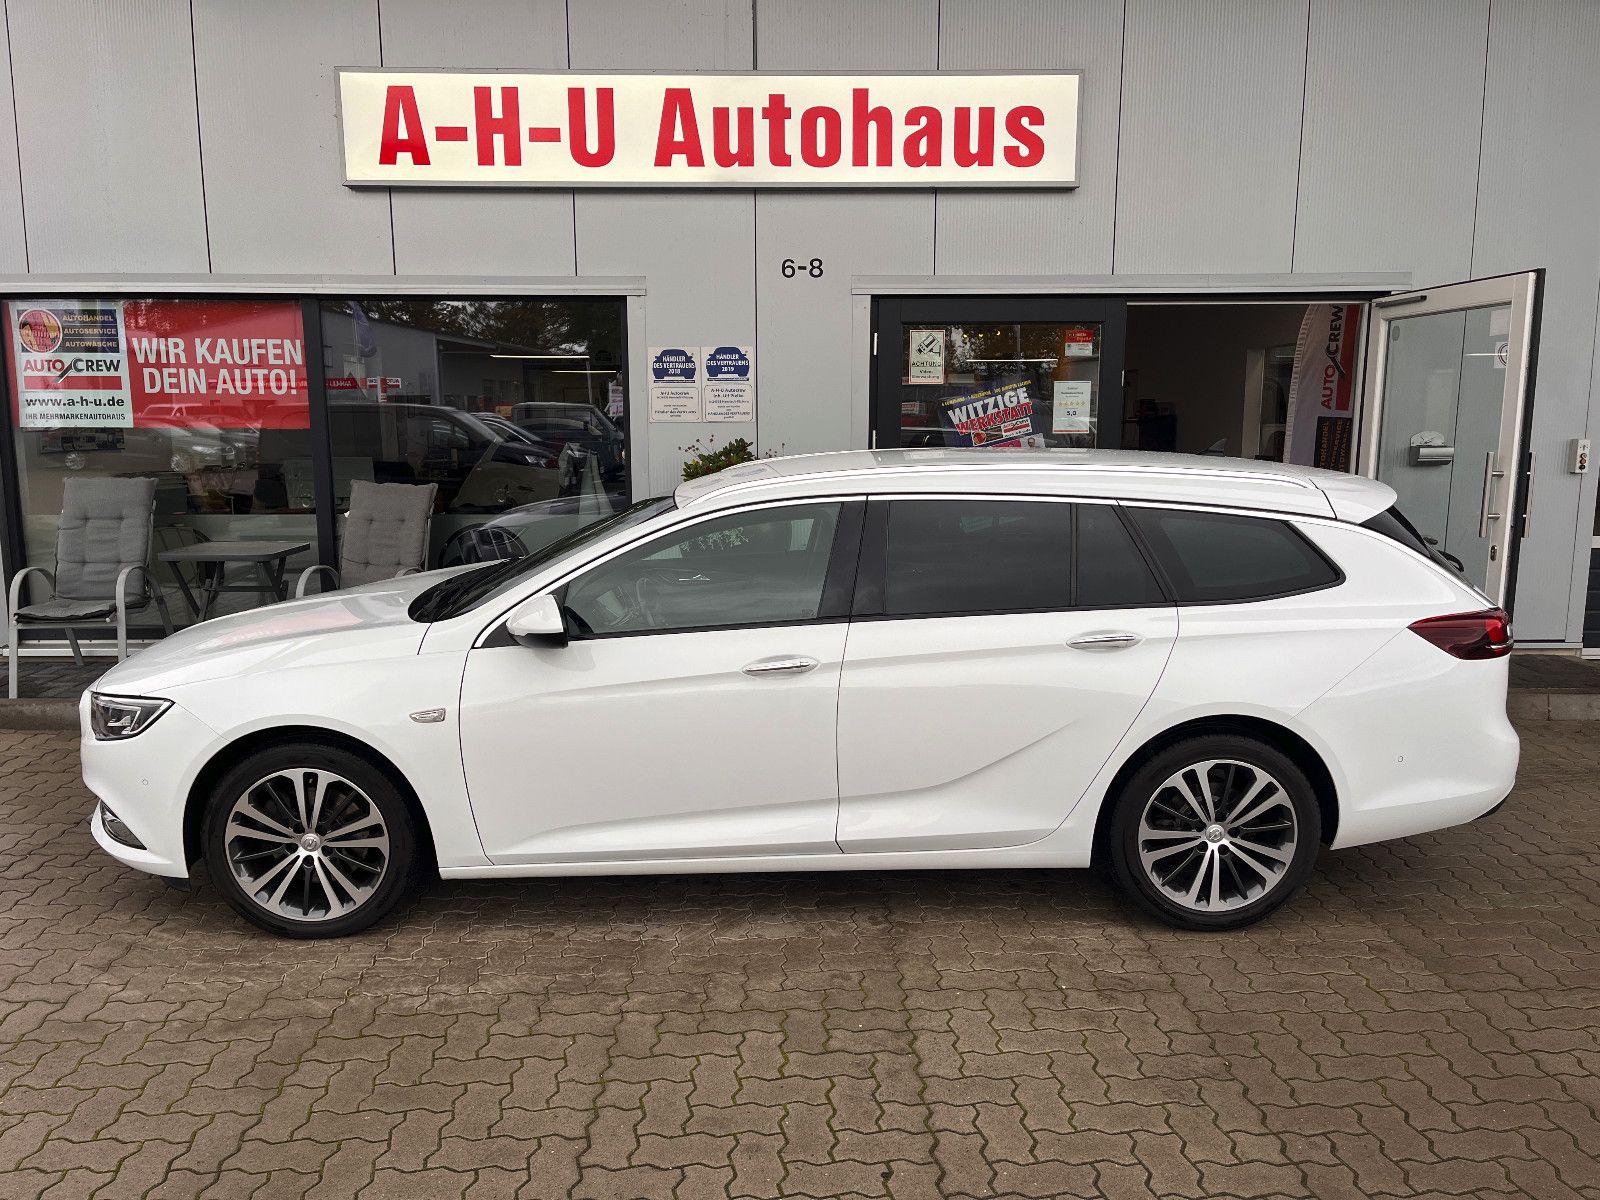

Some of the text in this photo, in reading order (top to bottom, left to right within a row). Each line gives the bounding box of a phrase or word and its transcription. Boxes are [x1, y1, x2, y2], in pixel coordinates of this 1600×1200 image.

[378, 85, 1046, 168] A-H-U Autohaus
[781, 258, 824, 279] 6-8
[62, 314, 114, 322] AUTOHANDEL
[23, 358, 121, 372] AUTO CREW
[132, 337, 303, 366] WIR KAUFEN
[1320, 303, 1344, 410] AUTO CREW
[142, 367, 297, 395] DEIN AUTO!
[25, 396, 125, 407] www.a-h-u.de
[947, 387, 1031, 423] WITZIGE
[955, 401, 1034, 436] WERKSTATT
[1319, 421, 1330, 467] TOHANDEL
